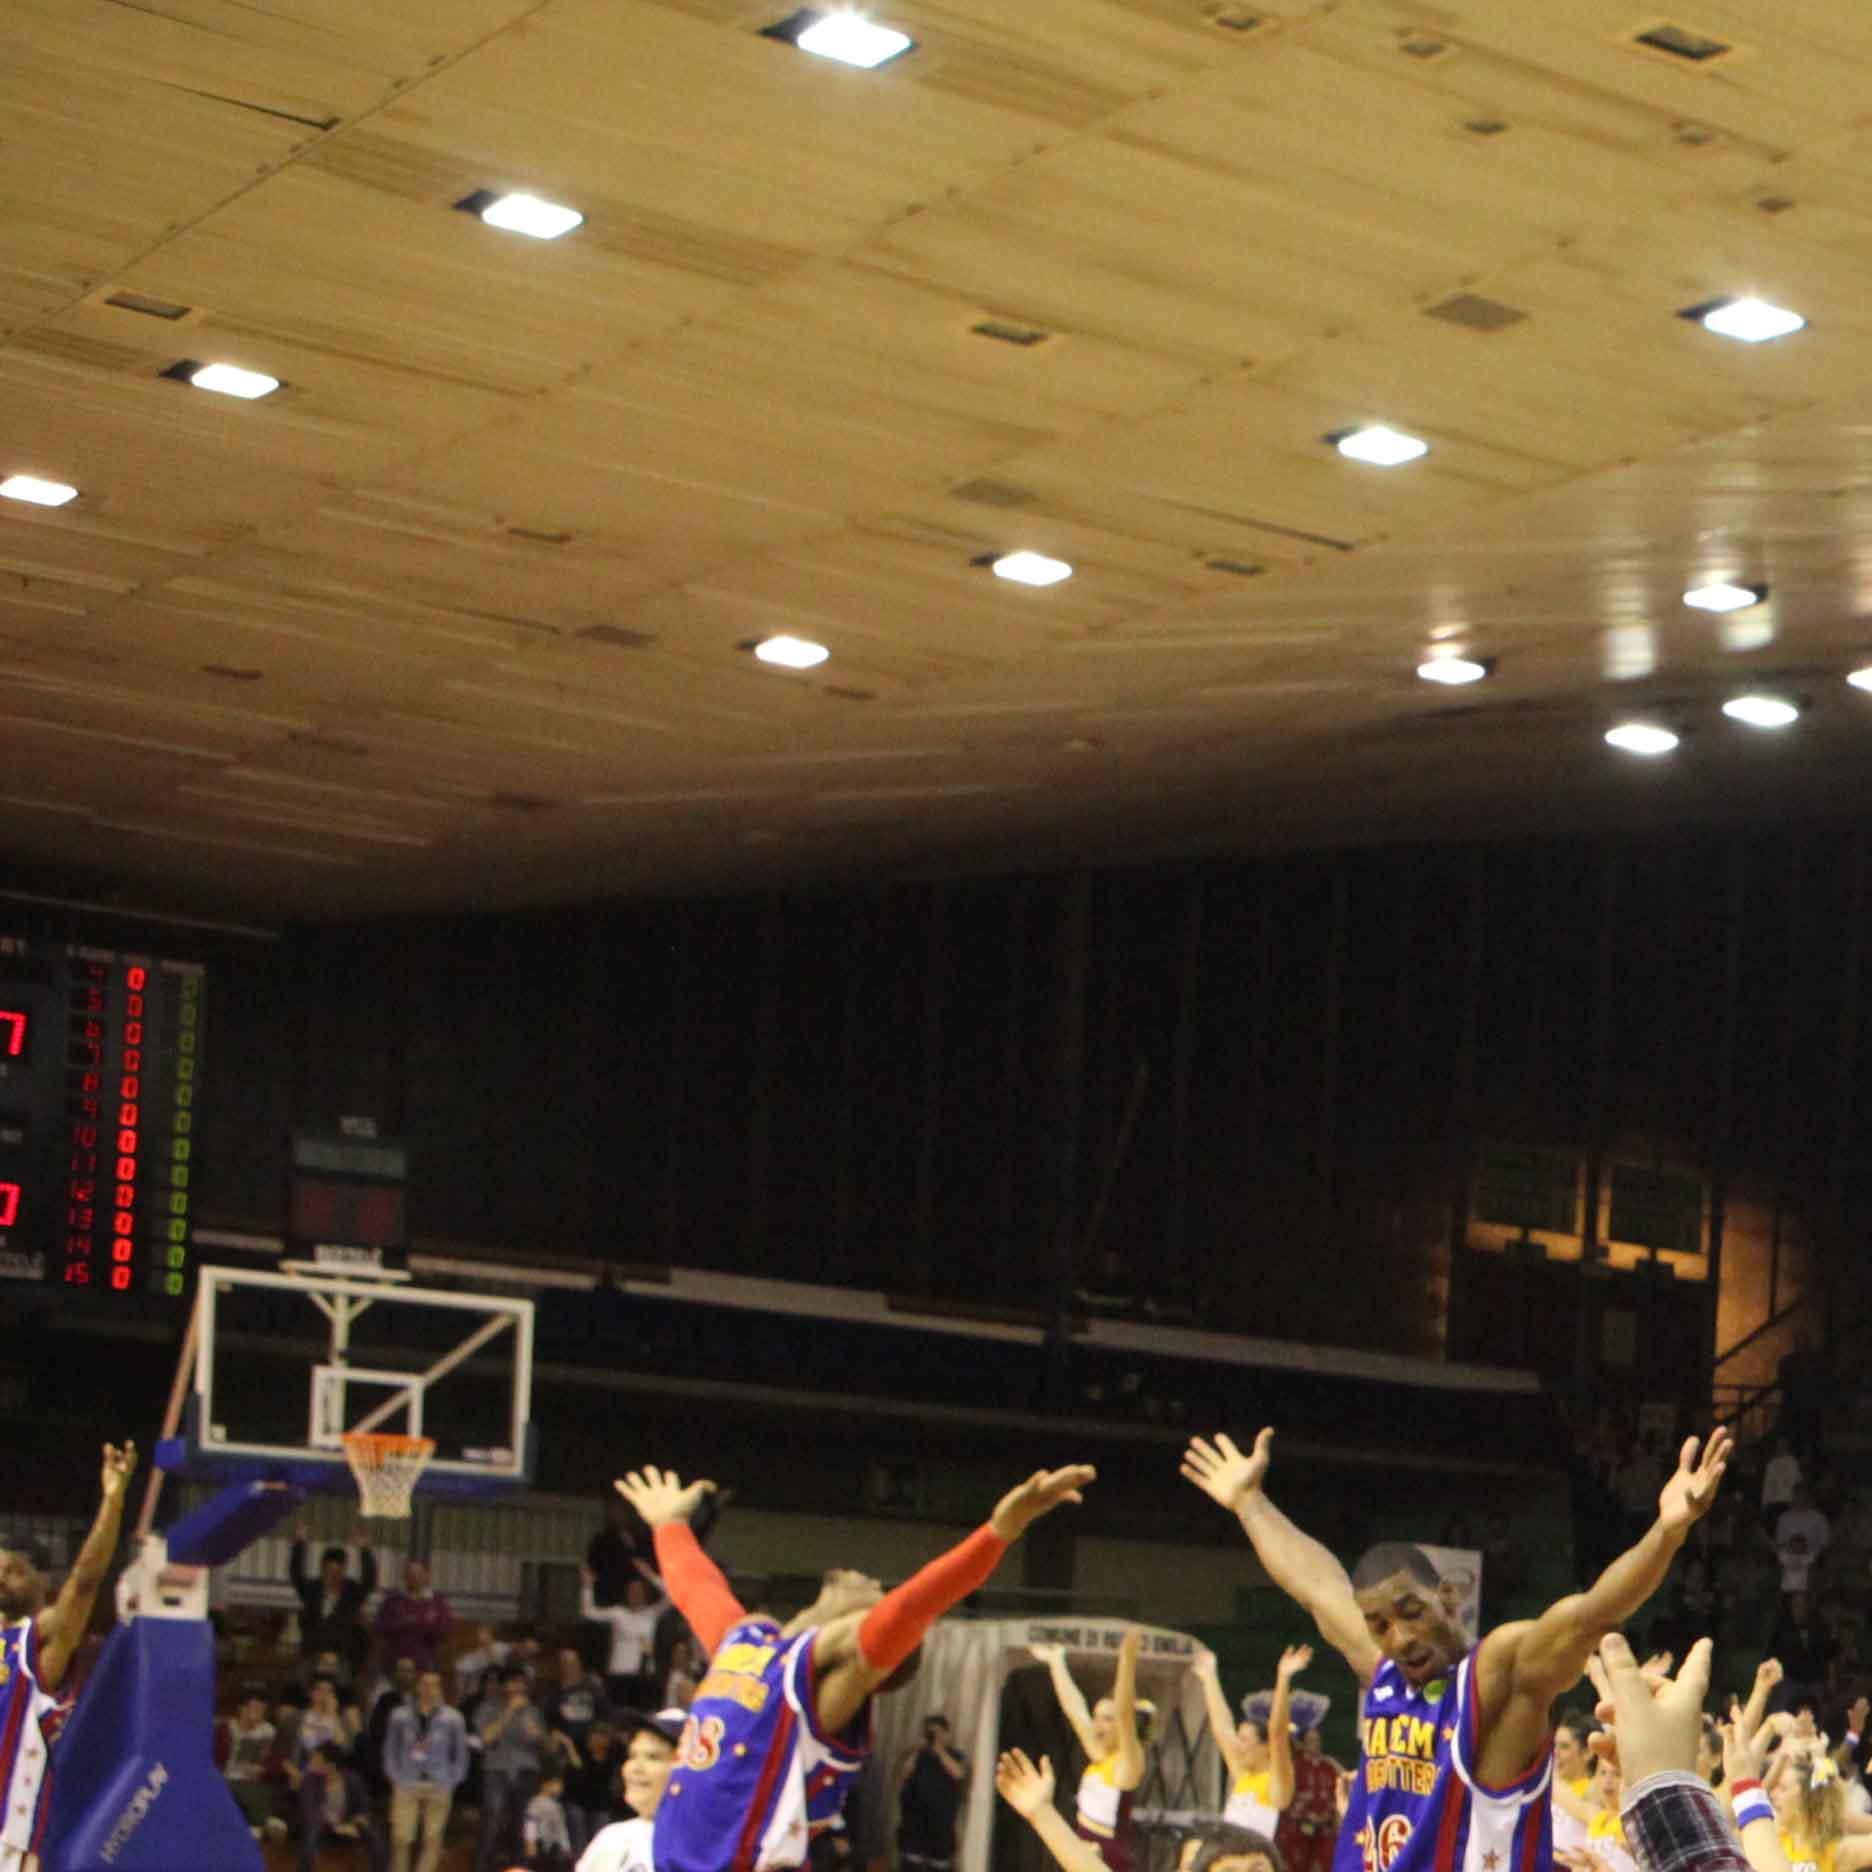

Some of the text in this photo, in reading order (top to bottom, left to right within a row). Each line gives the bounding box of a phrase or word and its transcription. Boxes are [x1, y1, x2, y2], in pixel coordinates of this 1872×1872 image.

[127, 966, 145, 991] 0
[120, 1075, 139, 1099] 0
[119, 1103, 138, 1127] 0
[118, 1129, 137, 1154] 0
[116, 1156, 136, 1181] 0
[115, 1184, 134, 1208] 0
[113, 1211, 133, 1235] 0
[112, 1237, 133, 1262] 0
[111, 1265, 131, 1290] 0
